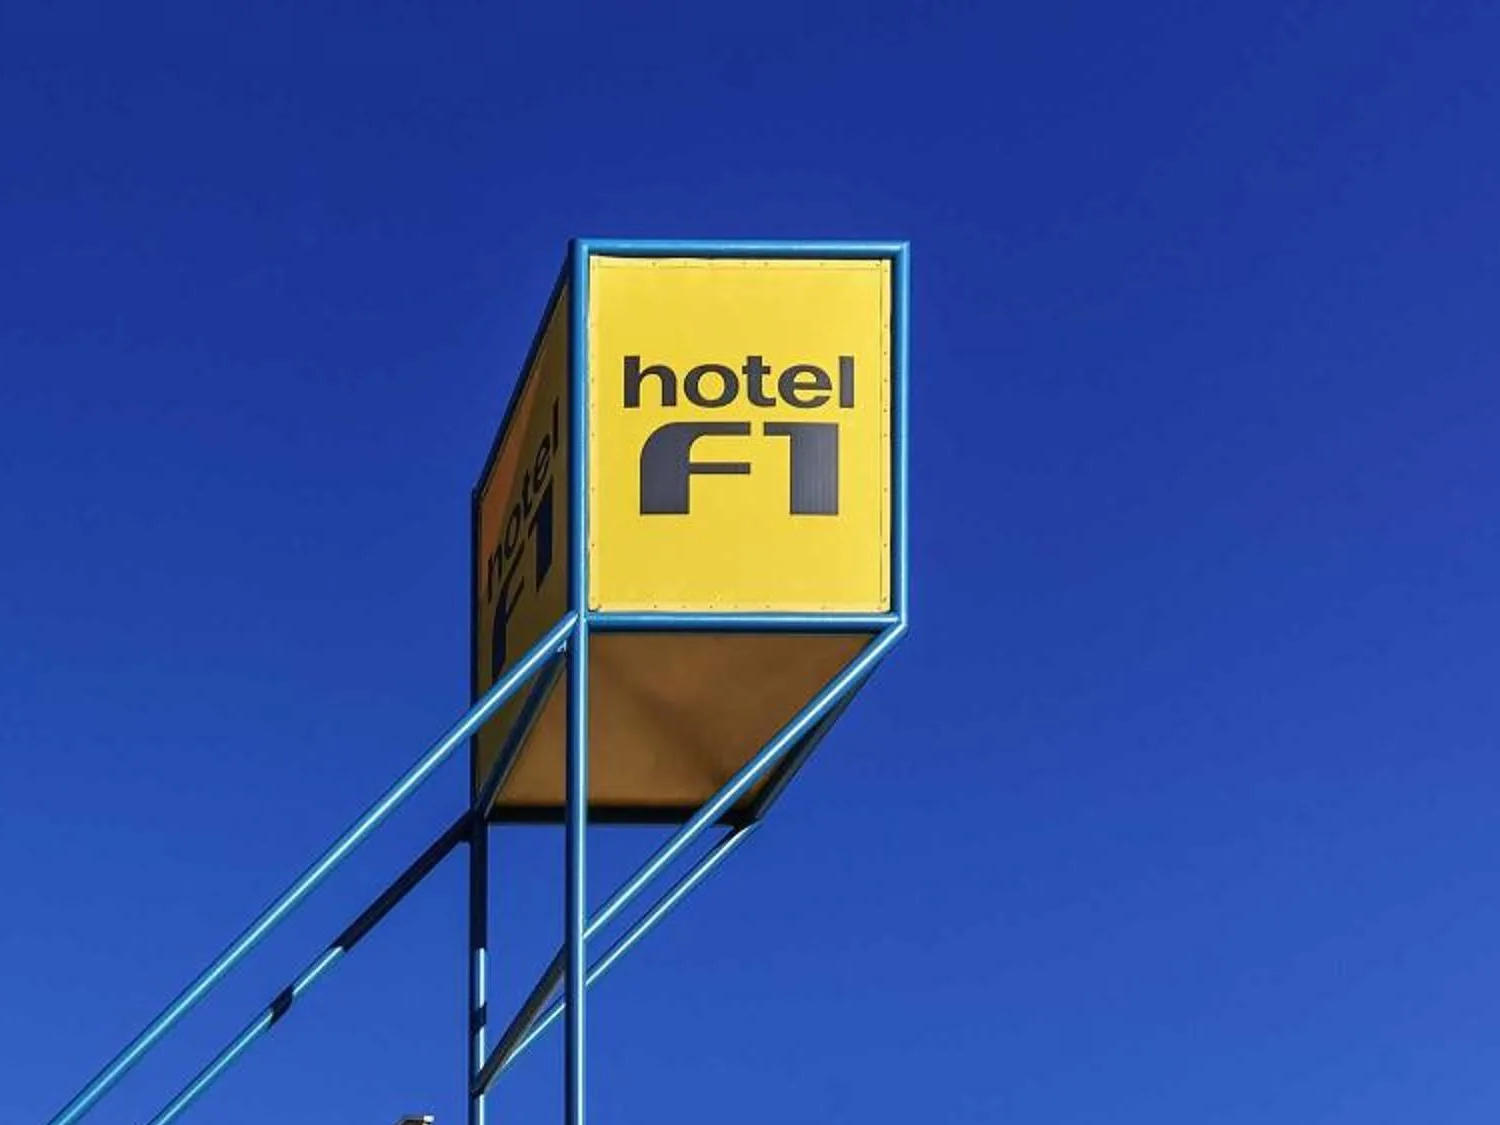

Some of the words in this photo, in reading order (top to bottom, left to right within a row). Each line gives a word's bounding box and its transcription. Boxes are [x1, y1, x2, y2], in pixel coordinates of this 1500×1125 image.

[623, 355, 855, 408] hotel
[487, 396, 560, 604] hotel
[639, 421, 839, 516] F1
